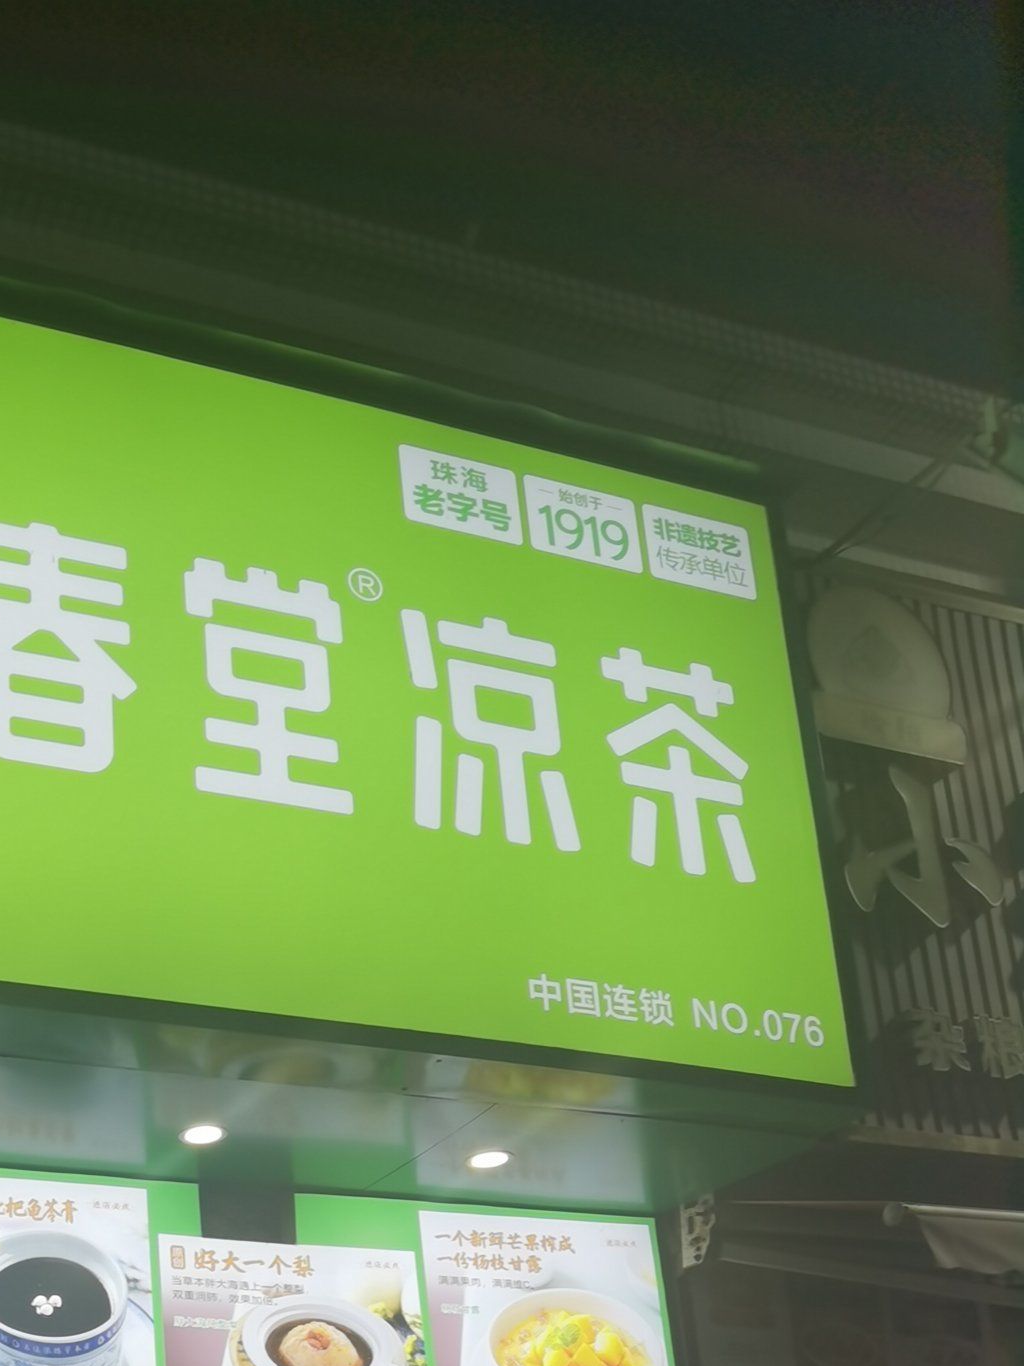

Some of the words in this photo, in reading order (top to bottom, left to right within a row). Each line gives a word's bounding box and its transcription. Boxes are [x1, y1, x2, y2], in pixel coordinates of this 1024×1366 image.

[430, 459, 488, 493] 珠海
[413, 483, 512, 533] 老字号
[558, 488, 603, 511] 始创于
[539, 504, 629, 561] 1919
[654, 517, 742, 558] 非遗技艺
[656, 546, 749, 588] 传承单位
[528, 973, 674, 1027] 中国连锁
[692, 998, 824, 1047] NO.076
[435, 1230, 575, 1254] 一个新鲜芒果榨成
[194, 1249, 314, 1277] 好大一个梨
[437, 1253, 542, 1273] 一份杨枝甘露
